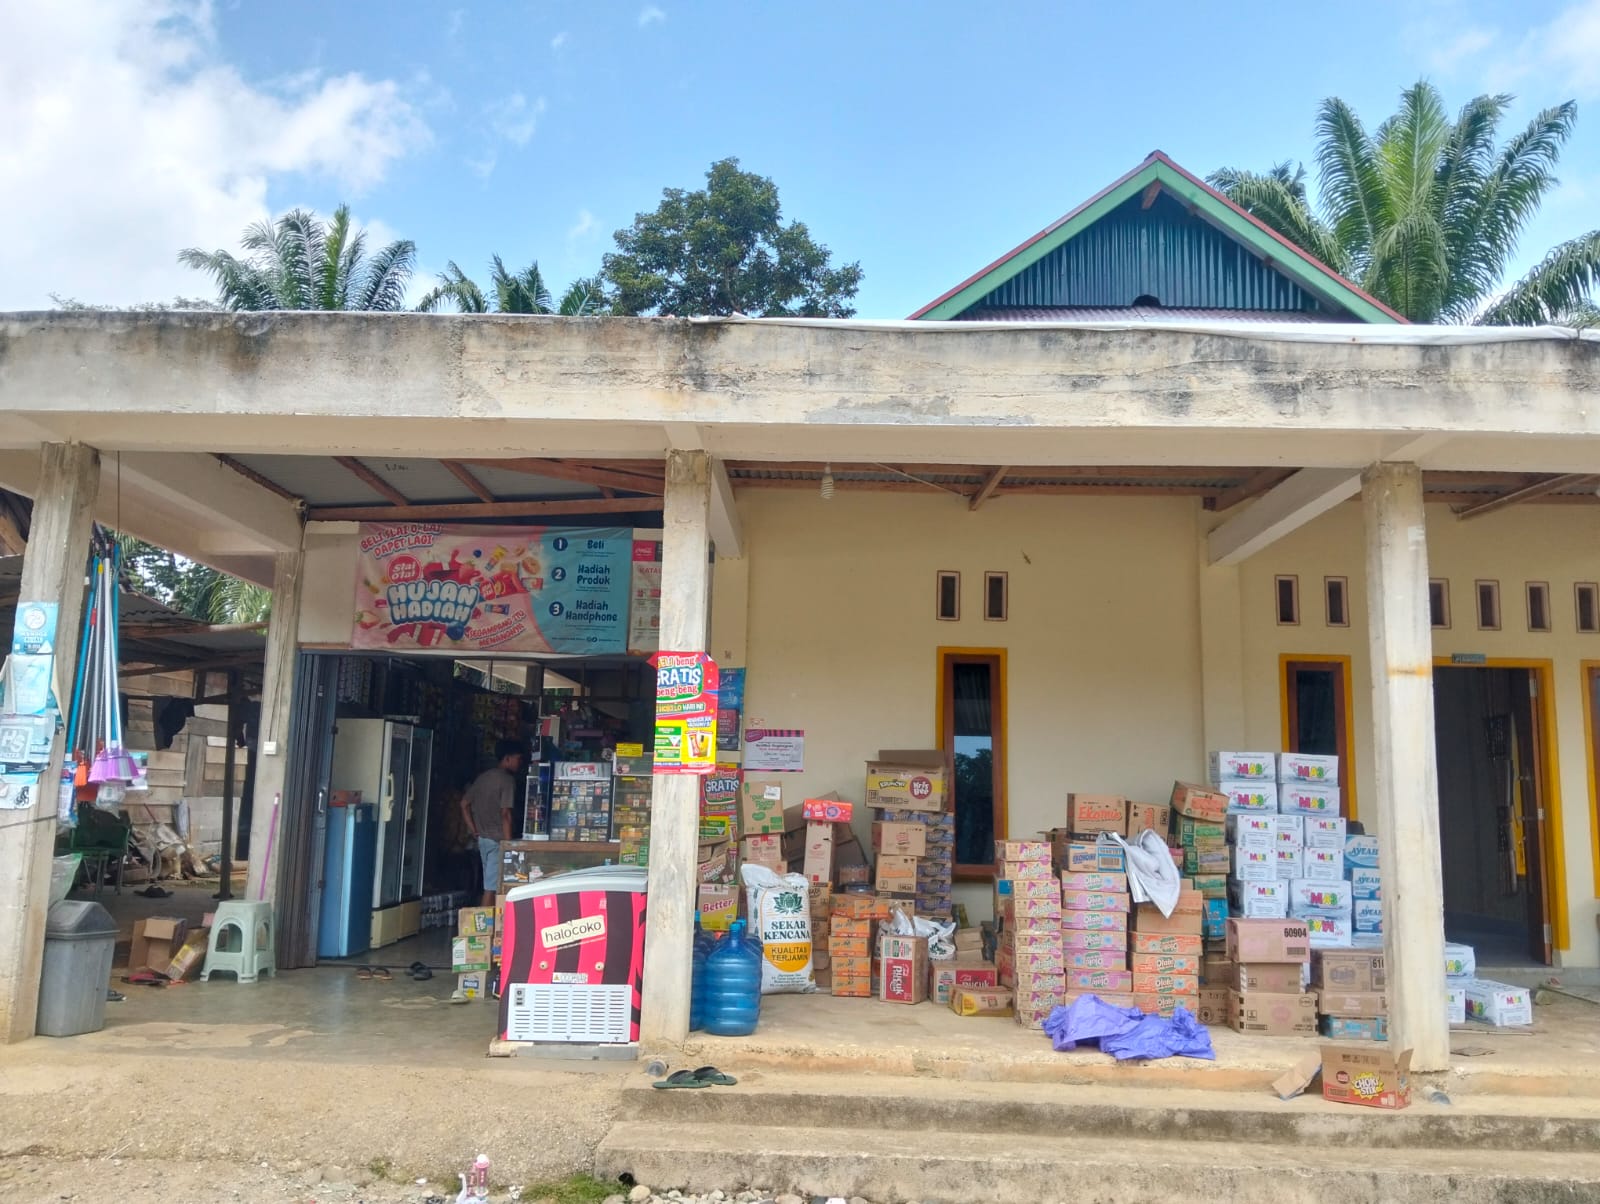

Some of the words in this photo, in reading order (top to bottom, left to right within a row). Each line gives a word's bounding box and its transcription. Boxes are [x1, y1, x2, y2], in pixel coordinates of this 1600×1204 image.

[361, 530, 383, 549] BELI
[587, 540, 604, 549] Beli
[374, 539, 406, 556] DAPET
[407, 535, 433, 546] LAGI
[578, 564, 610, 574] Hadiah
[577, 575, 610, 585] Produk
[388, 582, 478, 604] HUJAN
[576, 600, 608, 610] Hadiah
[391, 602, 471, 622] HADIAH
[565, 611, 618, 623] Handphone
[705, 779, 739, 792] GRATIS
[703, 900, 734, 913] Better
[771, 920, 806, 930] SEKAR
[545, 921, 602, 942] halocoko
[764, 930, 810, 940] KENCANA
[1284, 927, 1307, 937] 60904
[771, 946, 808, 954] KUALITAS
[892, 965, 905, 995] pucuk
[1354, 1078, 1379, 1089] CHOKI
